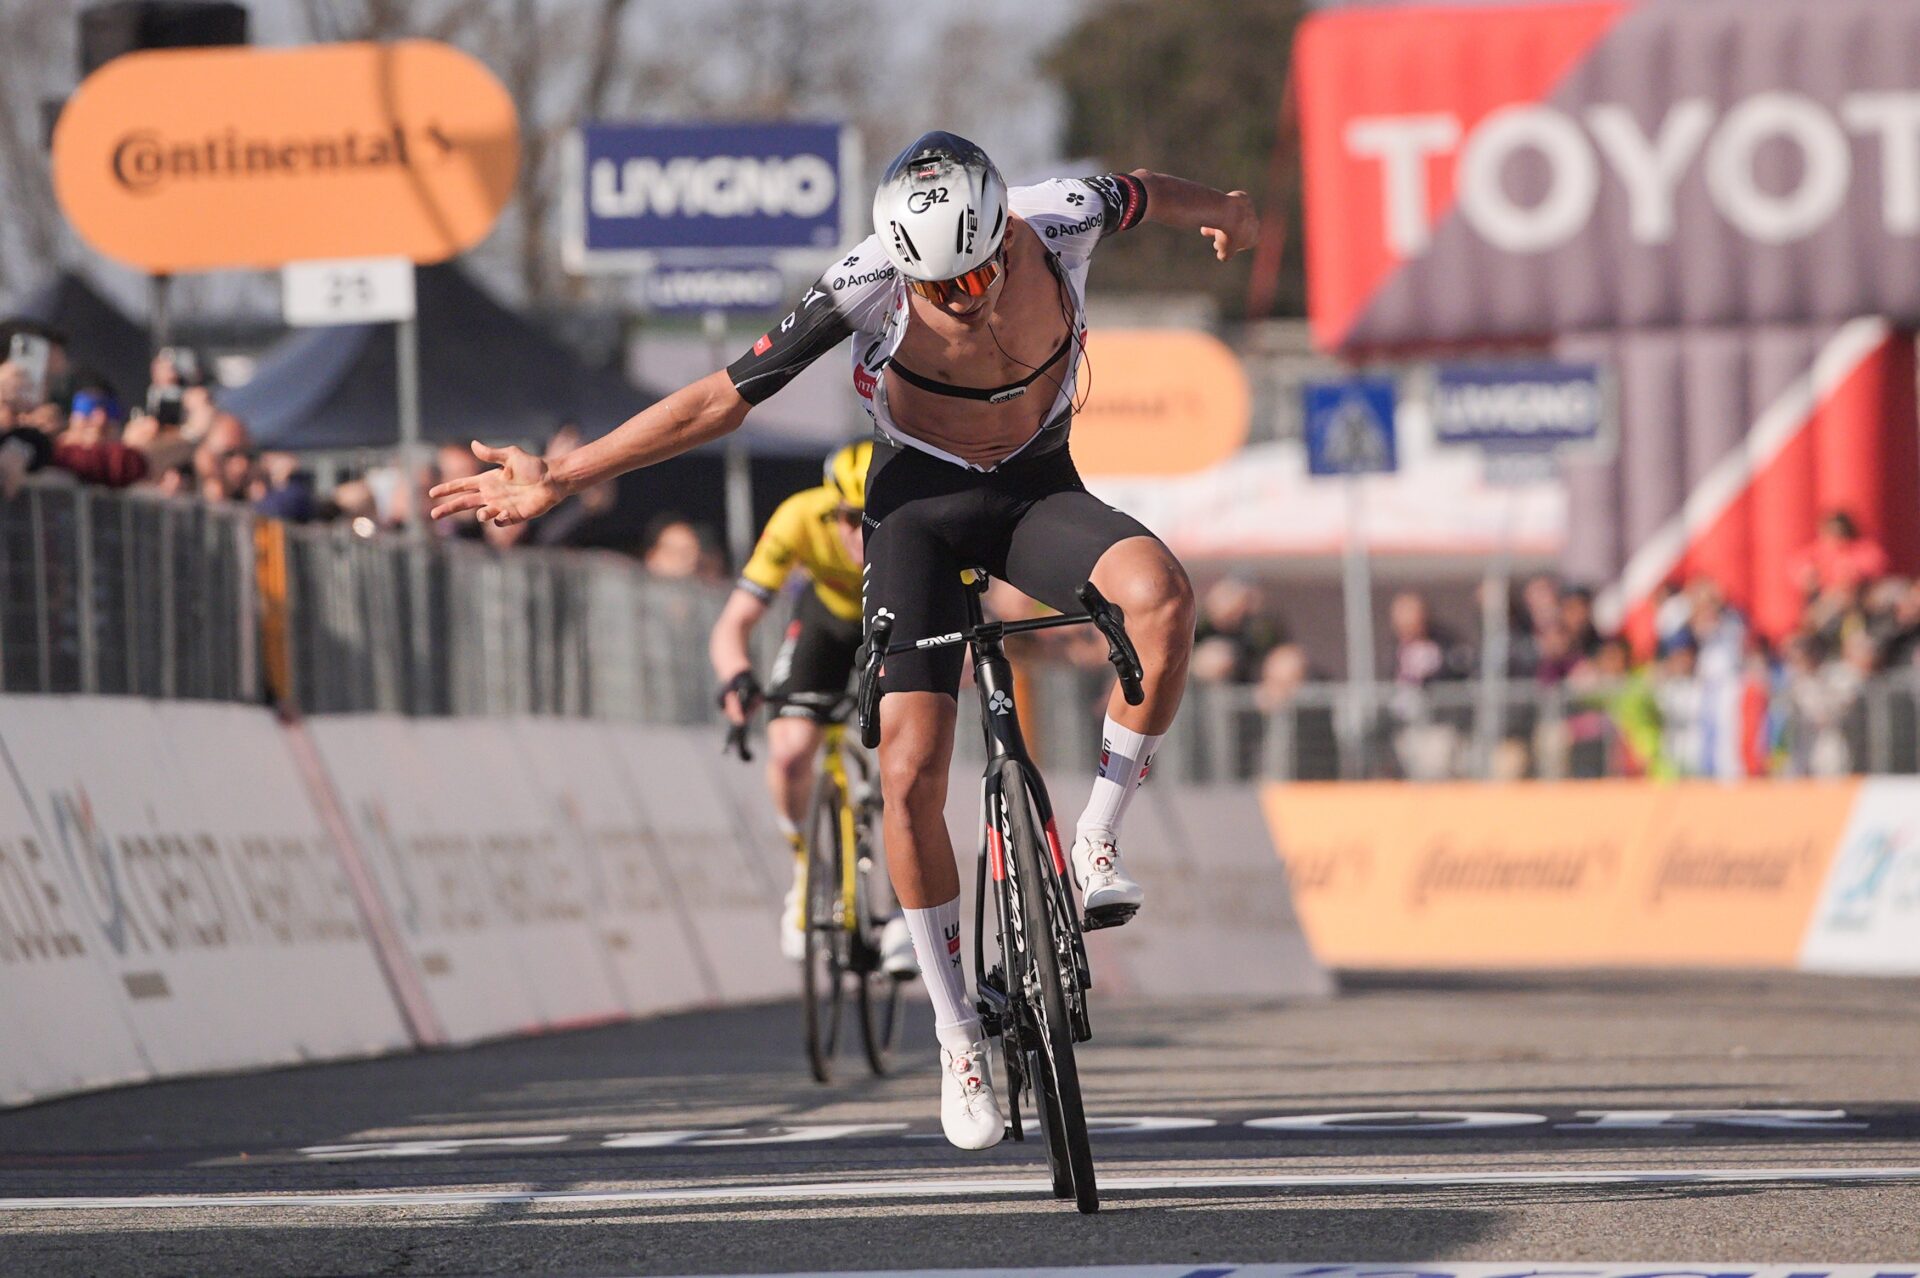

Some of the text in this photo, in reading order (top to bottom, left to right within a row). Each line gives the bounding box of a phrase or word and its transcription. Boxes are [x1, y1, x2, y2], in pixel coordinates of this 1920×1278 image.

[591, 154, 836, 219] LIVIGNO
[907, 187, 950, 214] G42
[964, 203, 978, 254] MET
[1060, 213, 1103, 236] Analog
[890, 220, 914, 266] MET
[847, 267, 896, 288] Analog
